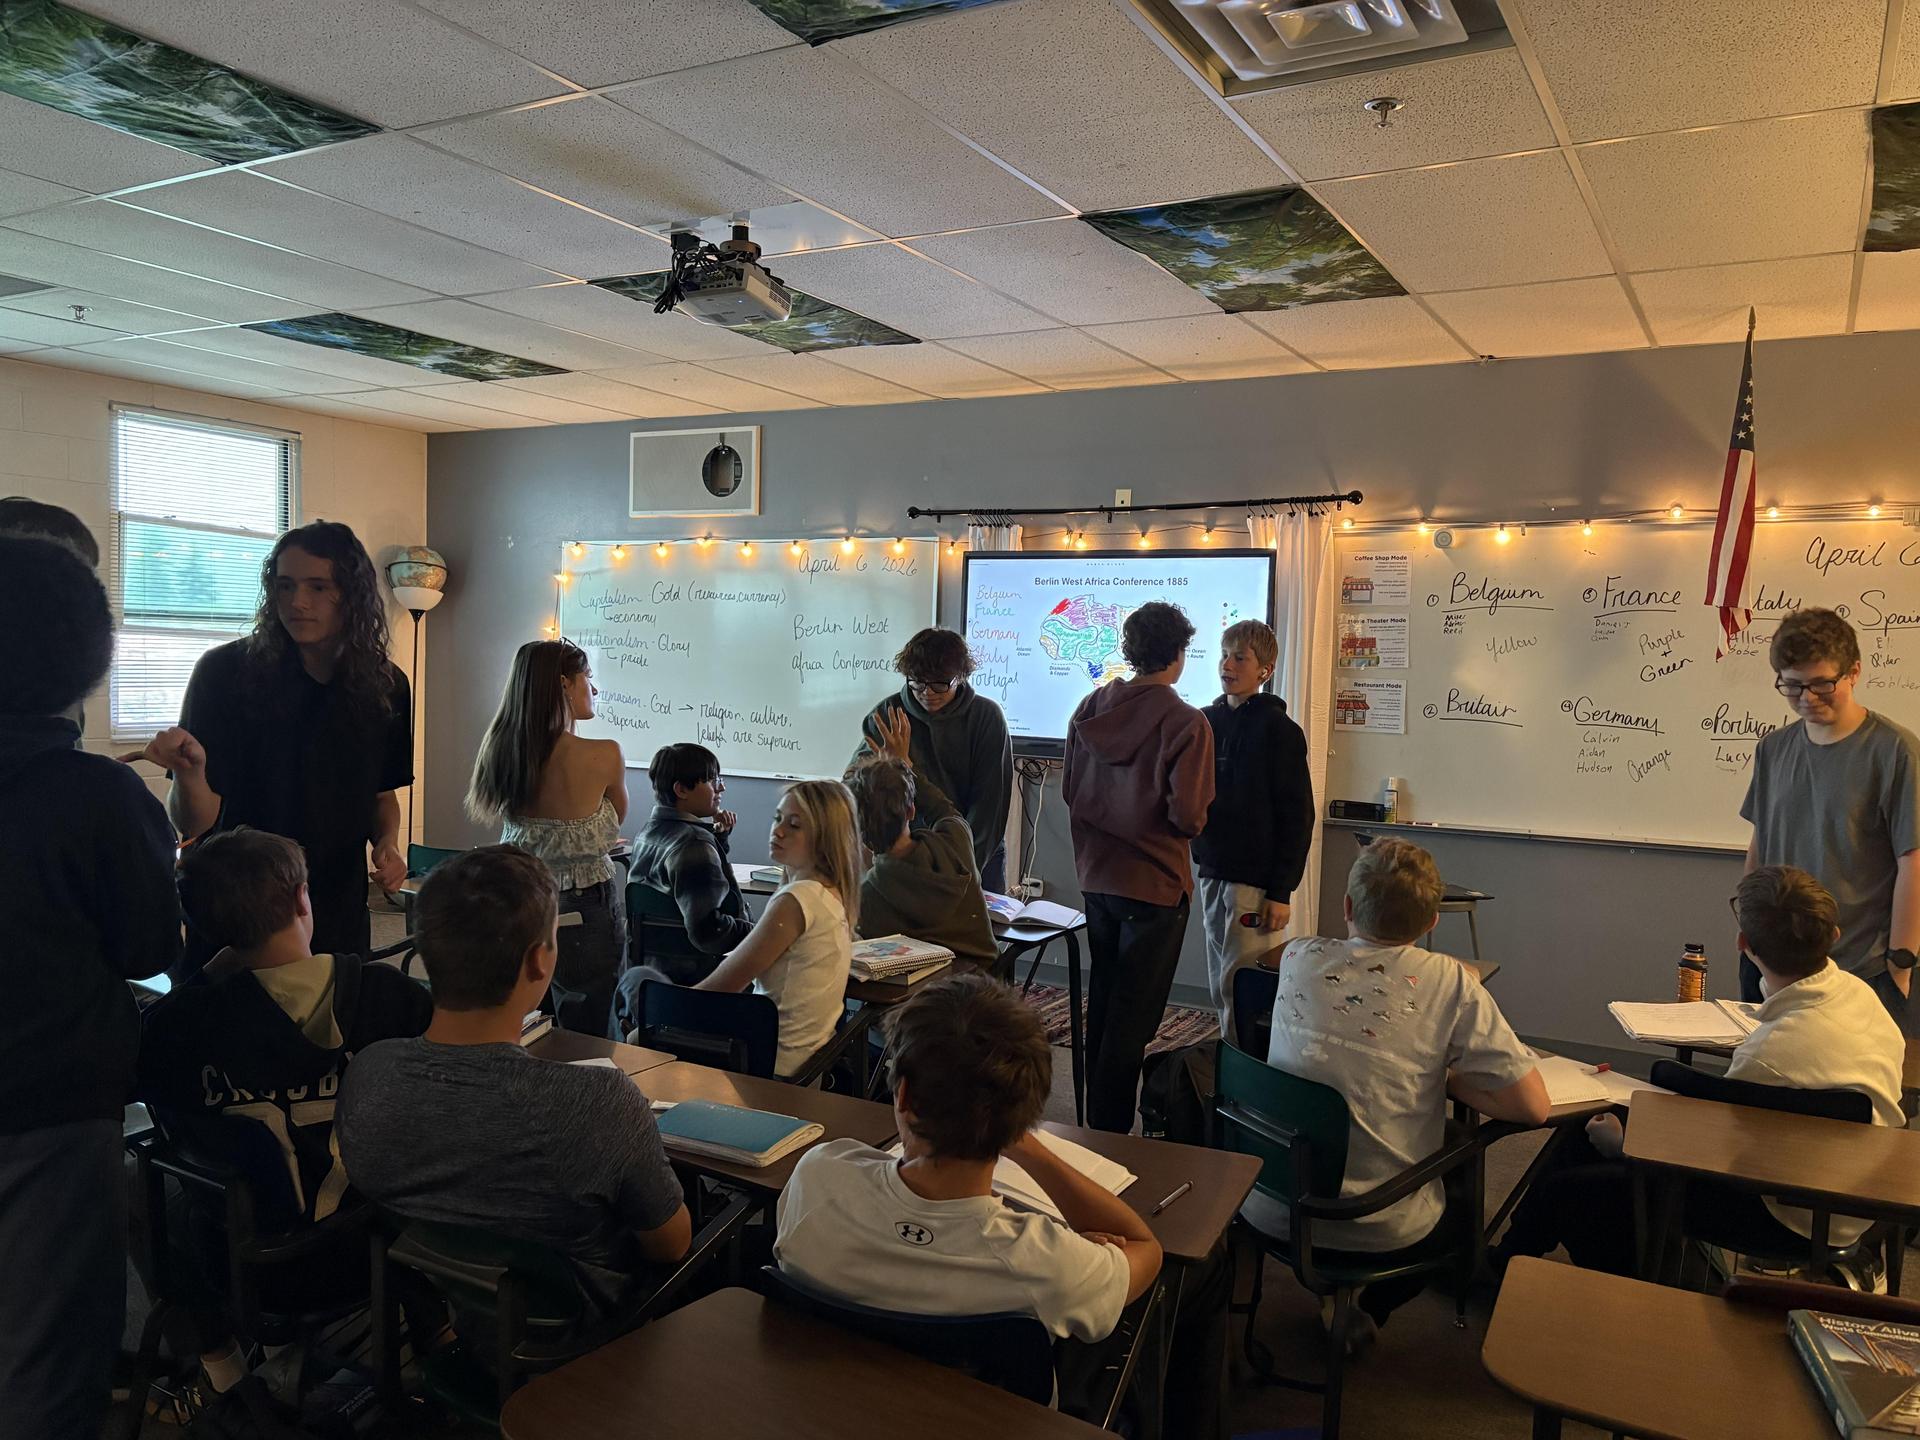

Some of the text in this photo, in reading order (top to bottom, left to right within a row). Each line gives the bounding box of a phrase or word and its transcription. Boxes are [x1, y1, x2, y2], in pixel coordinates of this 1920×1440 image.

[798, 550, 918, 584] April 6 2026
[1806, 536, 1886, 577] April
[651, 580, 681, 604] Gold
[1034, 577, 1188, 586] Berlin West Africa Conference 1885
[1449, 571, 1545, 616] Belgium
[1603, 575, 1682, 609] France
[976, 584, 1023, 608] Belgium
[1752, 584, 1802, 611] taly
[974, 602, 1016, 618] France
[852, 614, 889, 635] West
[971, 620, 1020, 646] Germany
[657, 633, 691, 658] Glory
[1485, 635, 1538, 664] Yellow
[1638, 628, 1686, 656] Purple
[1729, 630, 1773, 645] Alliso
[1640, 658, 1693, 683] Green
[650, 693, 672, 715] God
[1573, 695, 1659, 737] Germany
[607, 706, 651, 731] Superior
[733, 731, 752, 744] are
[1582, 730, 1621, 745] Calvin
[1578, 748, 1606, 759] Aidan
[1627, 748, 1672, 783] Orange
[1715, 745, 1752, 770] Lucy
[1576, 763, 1613, 775] Hudson
[1819, 1316, 1876, 1332] History
[1821, 1323, 1854, 1333] World
